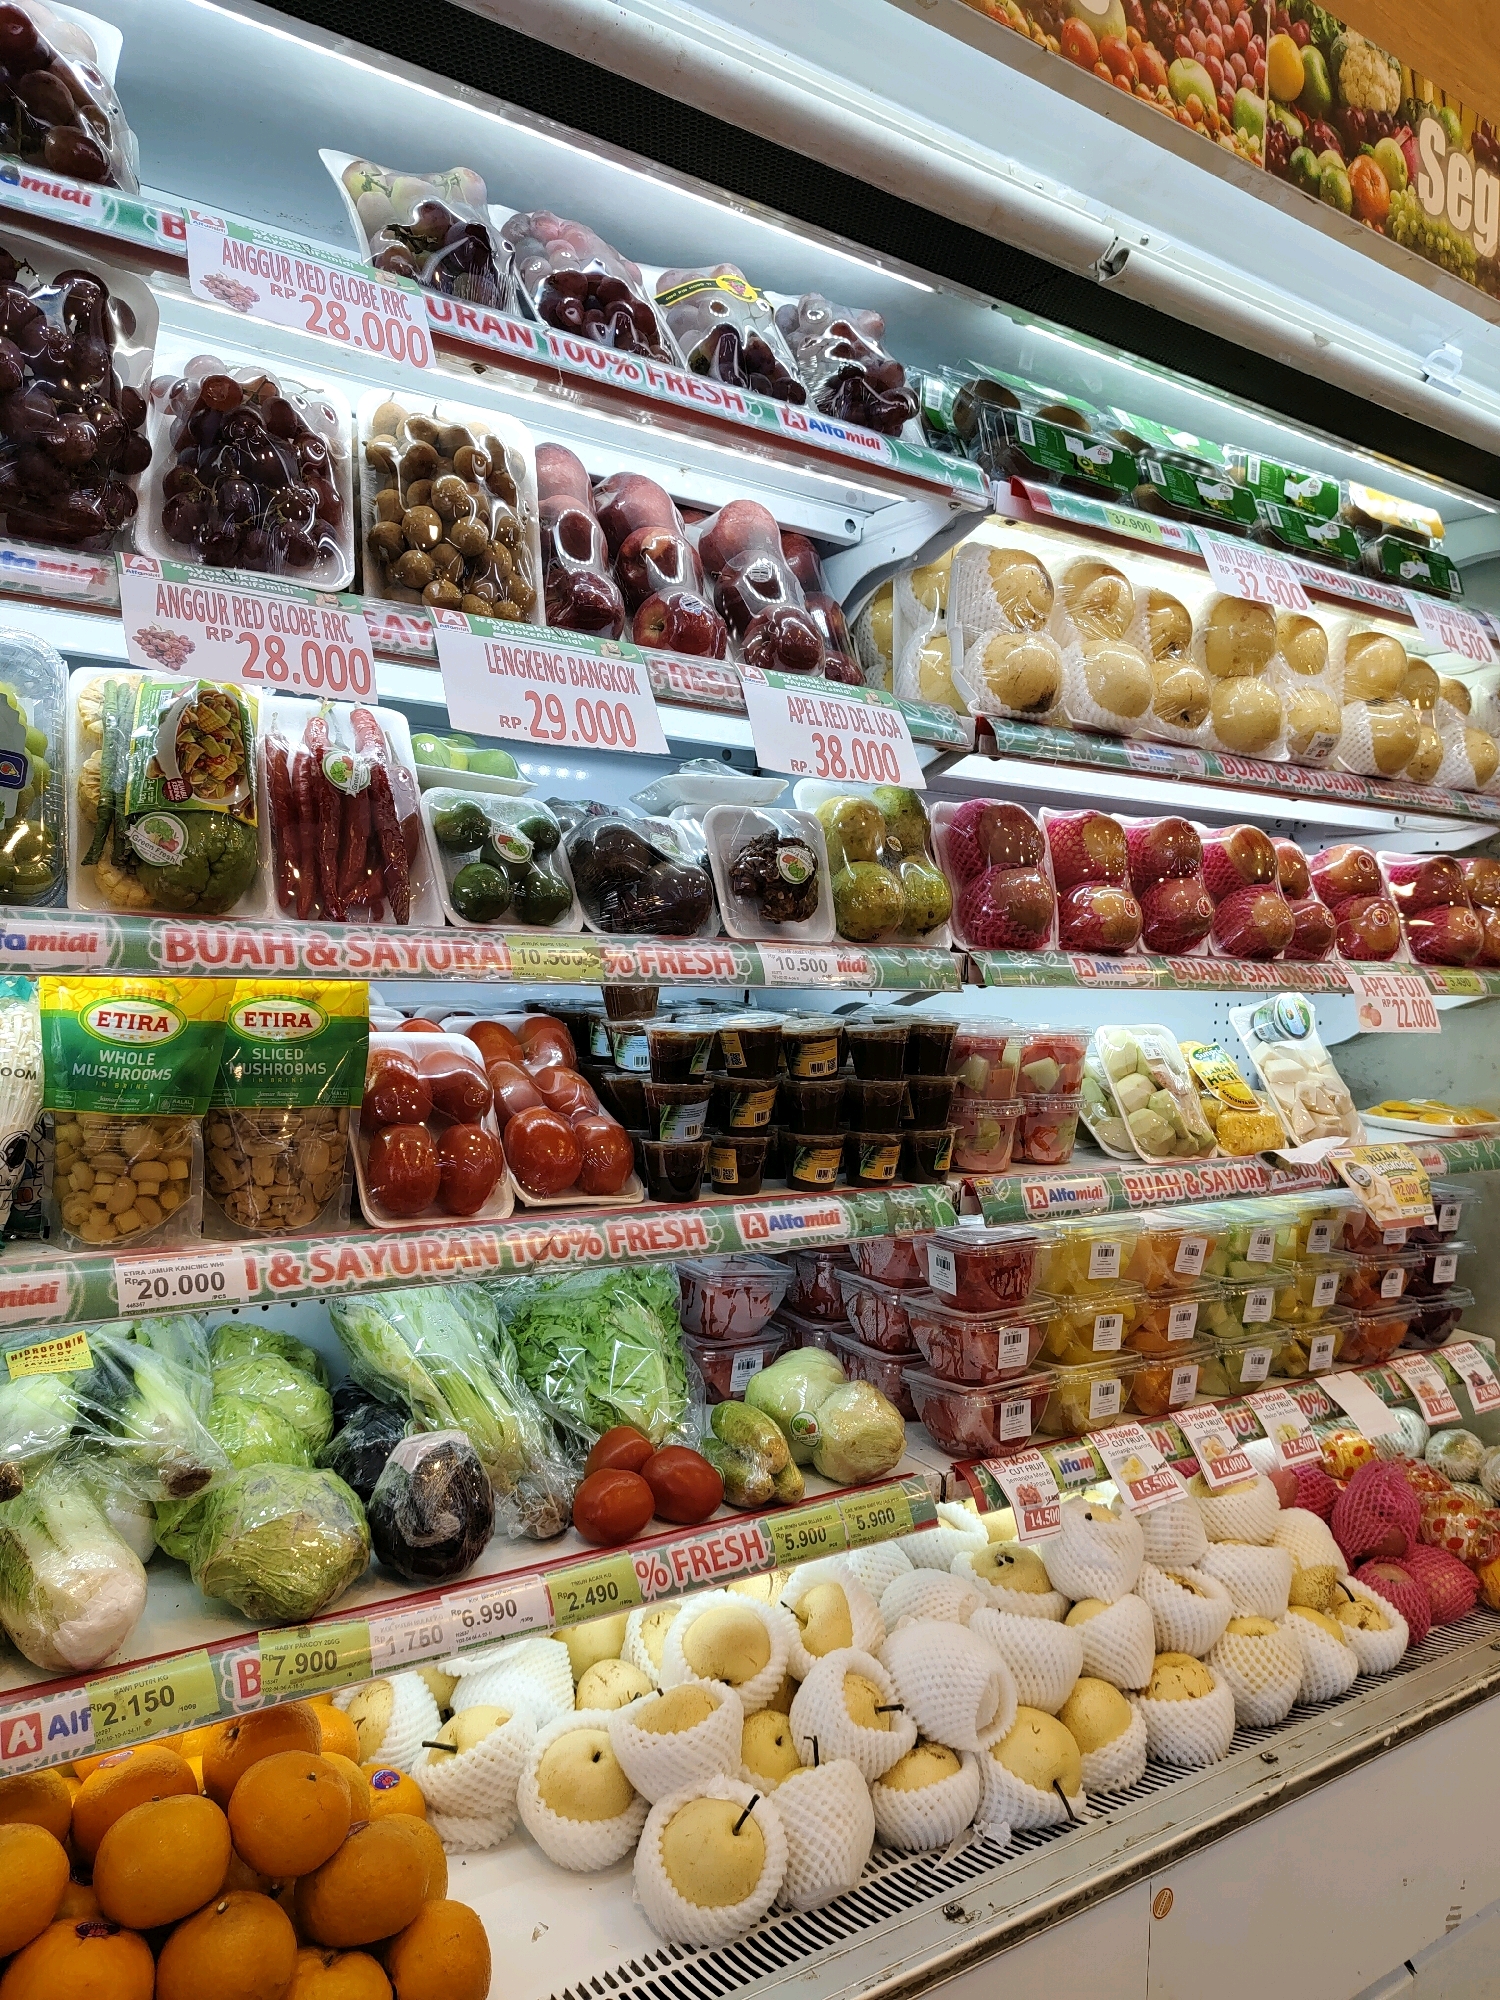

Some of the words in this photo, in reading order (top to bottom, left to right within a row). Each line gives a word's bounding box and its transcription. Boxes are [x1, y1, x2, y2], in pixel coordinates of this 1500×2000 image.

[222, 238, 294, 287] ANGGUR
[294, 260, 327, 296] RED
[329, 272, 381, 312] GLOBE
[380, 287, 412, 321] RRC
[301, 294, 429, 368] 28.000
[425, 295, 534, 350] URAN
[550, 336, 640, 381] 100%
[648, 363, 747, 415] FRESH
[808, 419, 882, 451] Alfamidi
[1112, 511, 1152, 534] 32.900
[1233, 567, 1308, 611] 32.900
[156, 583, 228, 625] ANGGUR
[233, 596, 264, 630] RED
[268, 602, 320, 638] GLOBE
[322, 610, 354, 644] RRC
[239, 631, 371, 695] 28.000
[484, 642, 567, 685] LENGKENG
[568, 657, 642, 696] BANGKOK
[499, 715, 528, 731] RP.
[524, 690, 637, 748] 29.000
[787, 695, 822, 726] APEL
[821, 700, 850, 730] RED
[850, 705, 876, 735] DEL
[876, 711, 903, 740] USA
[790, 759, 813, 774] RP.
[812, 732, 901, 783] 38.000
[1221, 755, 1272, 783] BUAH
[1273, 761, 1290, 782] &
[165, 928, 296, 966] BUAH
[302, 932, 337, 966] &
[517, 948, 583, 966] 10.500
[638, 946, 735, 976] FRESH
[775, 956, 829, 973] 10.500
[1096, 961, 1148, 975] Alfamidi
[1168, 960, 1224, 982] BUAH
[1225, 961, 1244, 981] &
[1242, 963, 1327, 985] SAYURAN
[1359, 976, 1398, 998] APEL
[1394, 976, 1426, 998] FUJI
[96, 1010, 170, 1033] ETIRA
[243, 1011, 314, 1029] ETIRA
[1393, 999, 1438, 1028] 22.000
[100, 1050, 156, 1066] WHOLE
[252, 1048, 304, 1061] SLICED
[72, 1063, 173, 1082] MUSHROOMS
[230, 1062, 327, 1075] MUSHROOMS
[114, 1082, 149, 1090] BRINE
[1049, 1184, 1104, 1204] Alfamidi
[1123, 1175, 1181, 1203] BUAH
[1184, 1175, 1201, 1194] &
[768, 1206, 842, 1233] Alfamidi
[269, 1253, 304, 1288] &
[310, 1234, 500, 1284] SAYURAN
[504, 1226, 604, 1263] 100%
[608, 1217, 708, 1254] FRESH
[123, 1267, 146, 1277] ETIRA
[147, 1265, 174, 1275] JAMUR
[175, 1263, 209, 1273] KANCING
[210, 1261, 225, 1270] WHI
[138, 1271, 226, 1300] 20.000
[10, 1334, 85, 1362] HIDROPONIK
[24, 1349, 73, 1361] PAKCOY
[1419, 1364, 1433, 1373] FRUIT
[1188, 1408, 1217, 1421] PROMO
[1265, 1403, 1277, 1412] CUT
[1277, 1399, 1294, 1410] FRUIT
[1429, 1397, 1455, 1413] 11.000
[1107, 1427, 1140, 1441] PROMO
[1193, 1420, 1206, 1430] CUT
[1206, 1417, 1224, 1427] FRUIT
[1111, 1440, 1126, 1448] CUT
[1126, 1434, 1147, 1445] FRUIT
[1285, 1436, 1315, 1456] 12.500
[1003, 1453, 1040, 1467] PROMO
[1008, 1468, 1025, 1476] CUT
[1025, 1461, 1046, 1473] FRUIT
[1217, 1455, 1249, 1476] 14.000
[1135, 1472, 1174, 1496] 15.500
[855, 1507, 896, 1531] 5.900
[1029, 1507, 1060, 1528] 14.500
[784, 1526, 827, 1551] 5.900
[635, 1556, 668, 1592] %
[671, 1529, 764, 1582] FRESH
[567, 1581, 619, 1613] 2.490
[461, 1599, 518, 1628] 6.990
[262, 1653, 274, 1662] Rp
[272, 1649, 338, 1677] 7.900
[113, 1684, 133, 1696] SAWI
[89, 1702, 103, 1713] Rp
[102, 1685, 175, 1727] 2.150
